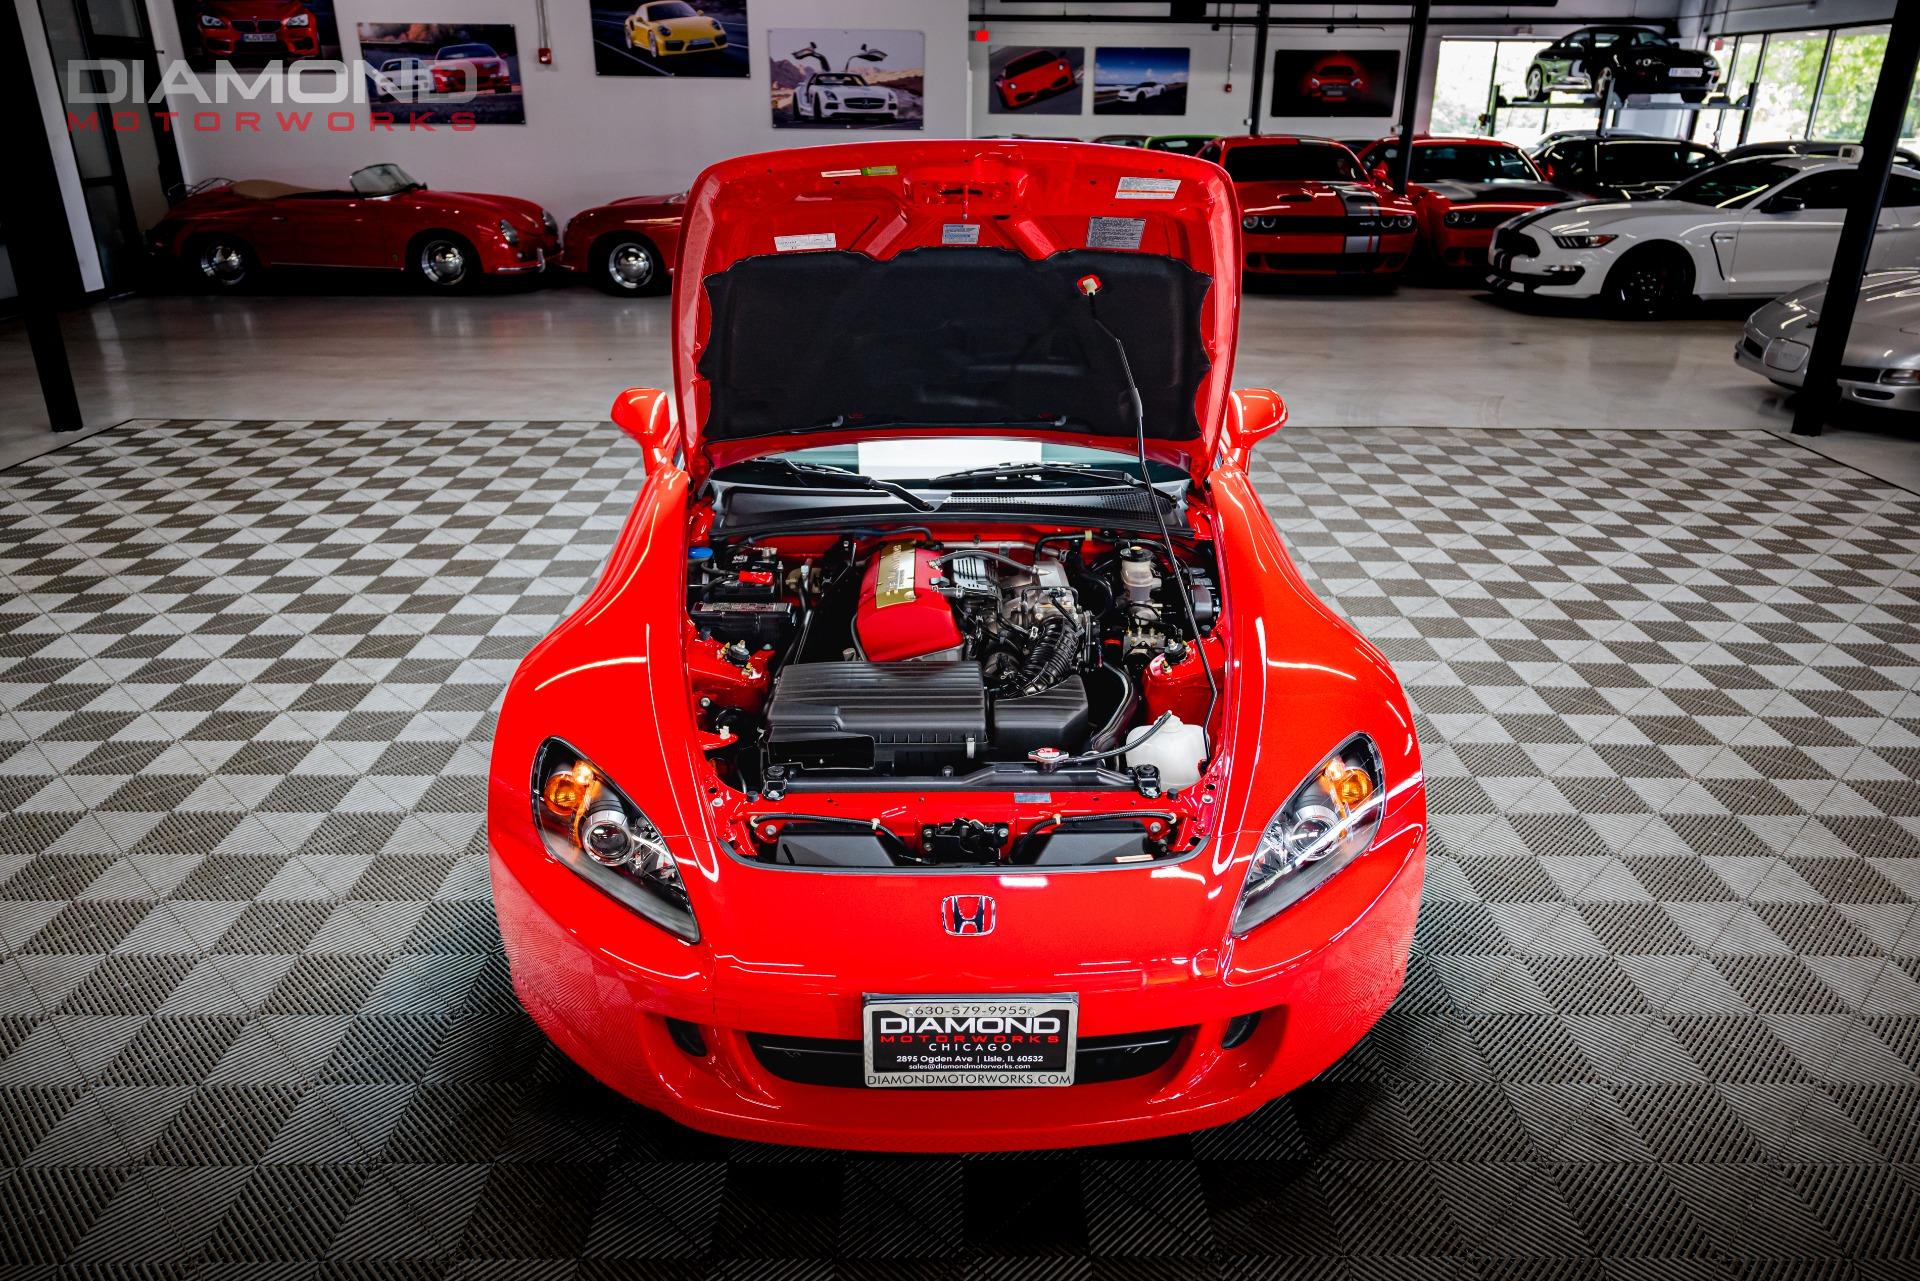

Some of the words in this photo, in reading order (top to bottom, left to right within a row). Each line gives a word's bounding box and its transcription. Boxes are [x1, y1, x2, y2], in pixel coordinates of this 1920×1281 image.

[915, 1006, 1026, 1015] 630-579-9955
[880, 1017, 1061, 1034] DIAMOND
[880, 1035, 1060, 1043] MOTORWORKS
[928, 1043, 1012, 1052] CHICAGO
[920, 1055, 952, 1064] Ogden
[867, 1074, 1071, 1085] DIAMONDMOTORWORKS.COM
